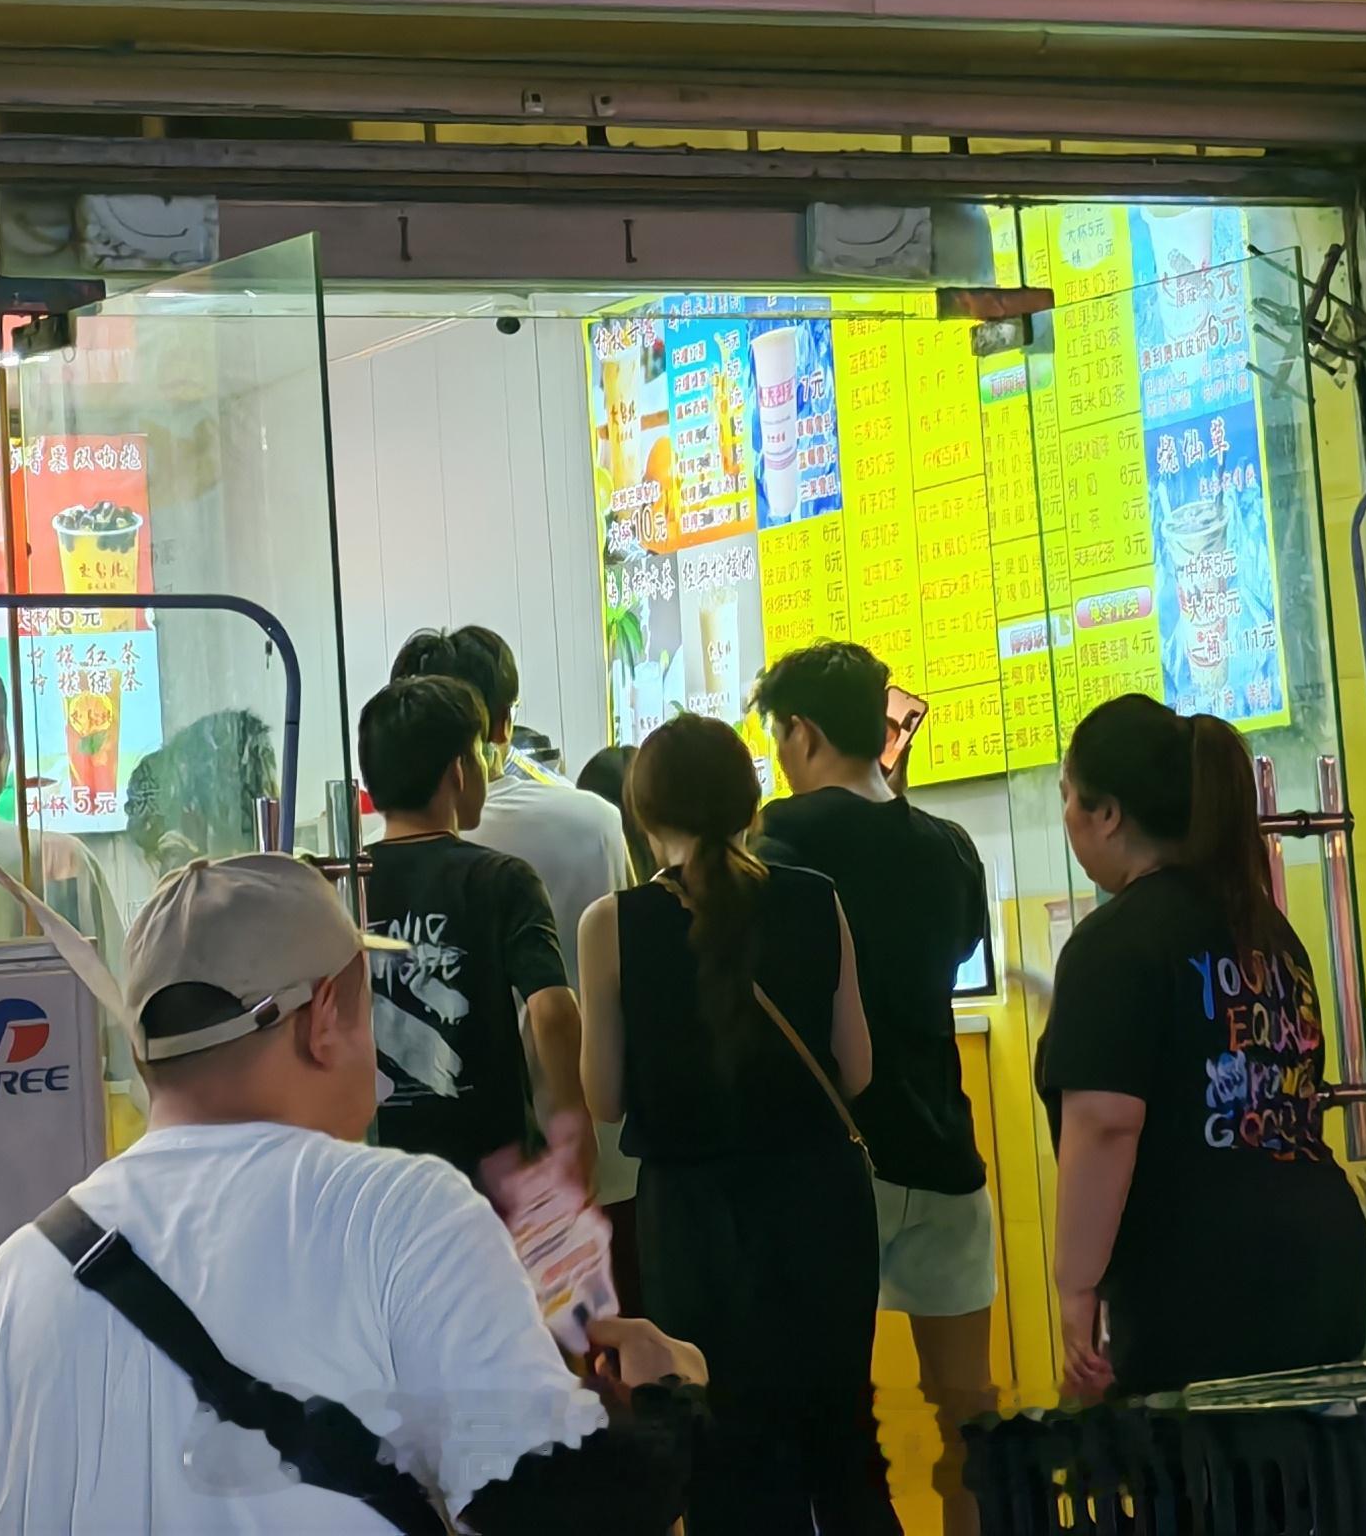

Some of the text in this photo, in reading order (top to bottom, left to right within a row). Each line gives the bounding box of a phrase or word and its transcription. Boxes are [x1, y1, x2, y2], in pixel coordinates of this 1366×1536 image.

[1067, 327, 1121, 358] 红豆奶茶
[1069, 355, 1124, 387] 布丁奶茶
[1070, 383, 1126, 416] 西米奶茶
[1157, 416, 1230, 474] 烧仙草
